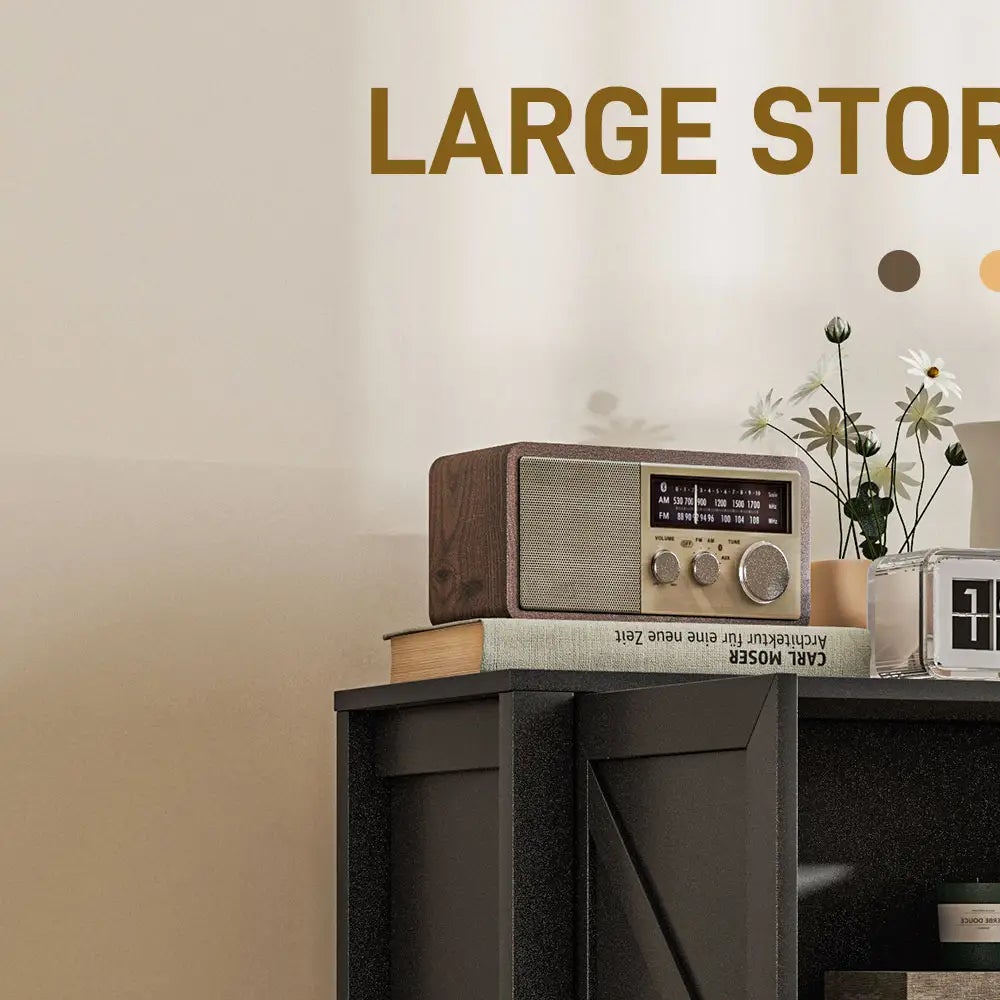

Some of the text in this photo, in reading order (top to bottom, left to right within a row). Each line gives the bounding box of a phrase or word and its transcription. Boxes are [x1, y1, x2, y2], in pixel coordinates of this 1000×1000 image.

[658, 496, 670, 504] AM
[673, 496, 684, 505] 530
[684, 497, 694, 506] 700
[714, 498, 727, 508] 1200
[732, 499, 745, 509] 1500
[747, 500, 761, 510] 1700
[658, 512, 670, 520] FM
[677, 512, 684, 521] 88
[685, 513, 692, 522] 90
[700, 513, 707, 522] 94
[707, 514, 715, 523] 96
[721, 514, 731, 523] 100
[734, 515, 745, 524] 104
[749, 516, 760, 525] 108
[615, 630, 827, 650] Architektur für eine neue Zeit
[729, 650, 827, 667] CARL MOSER
